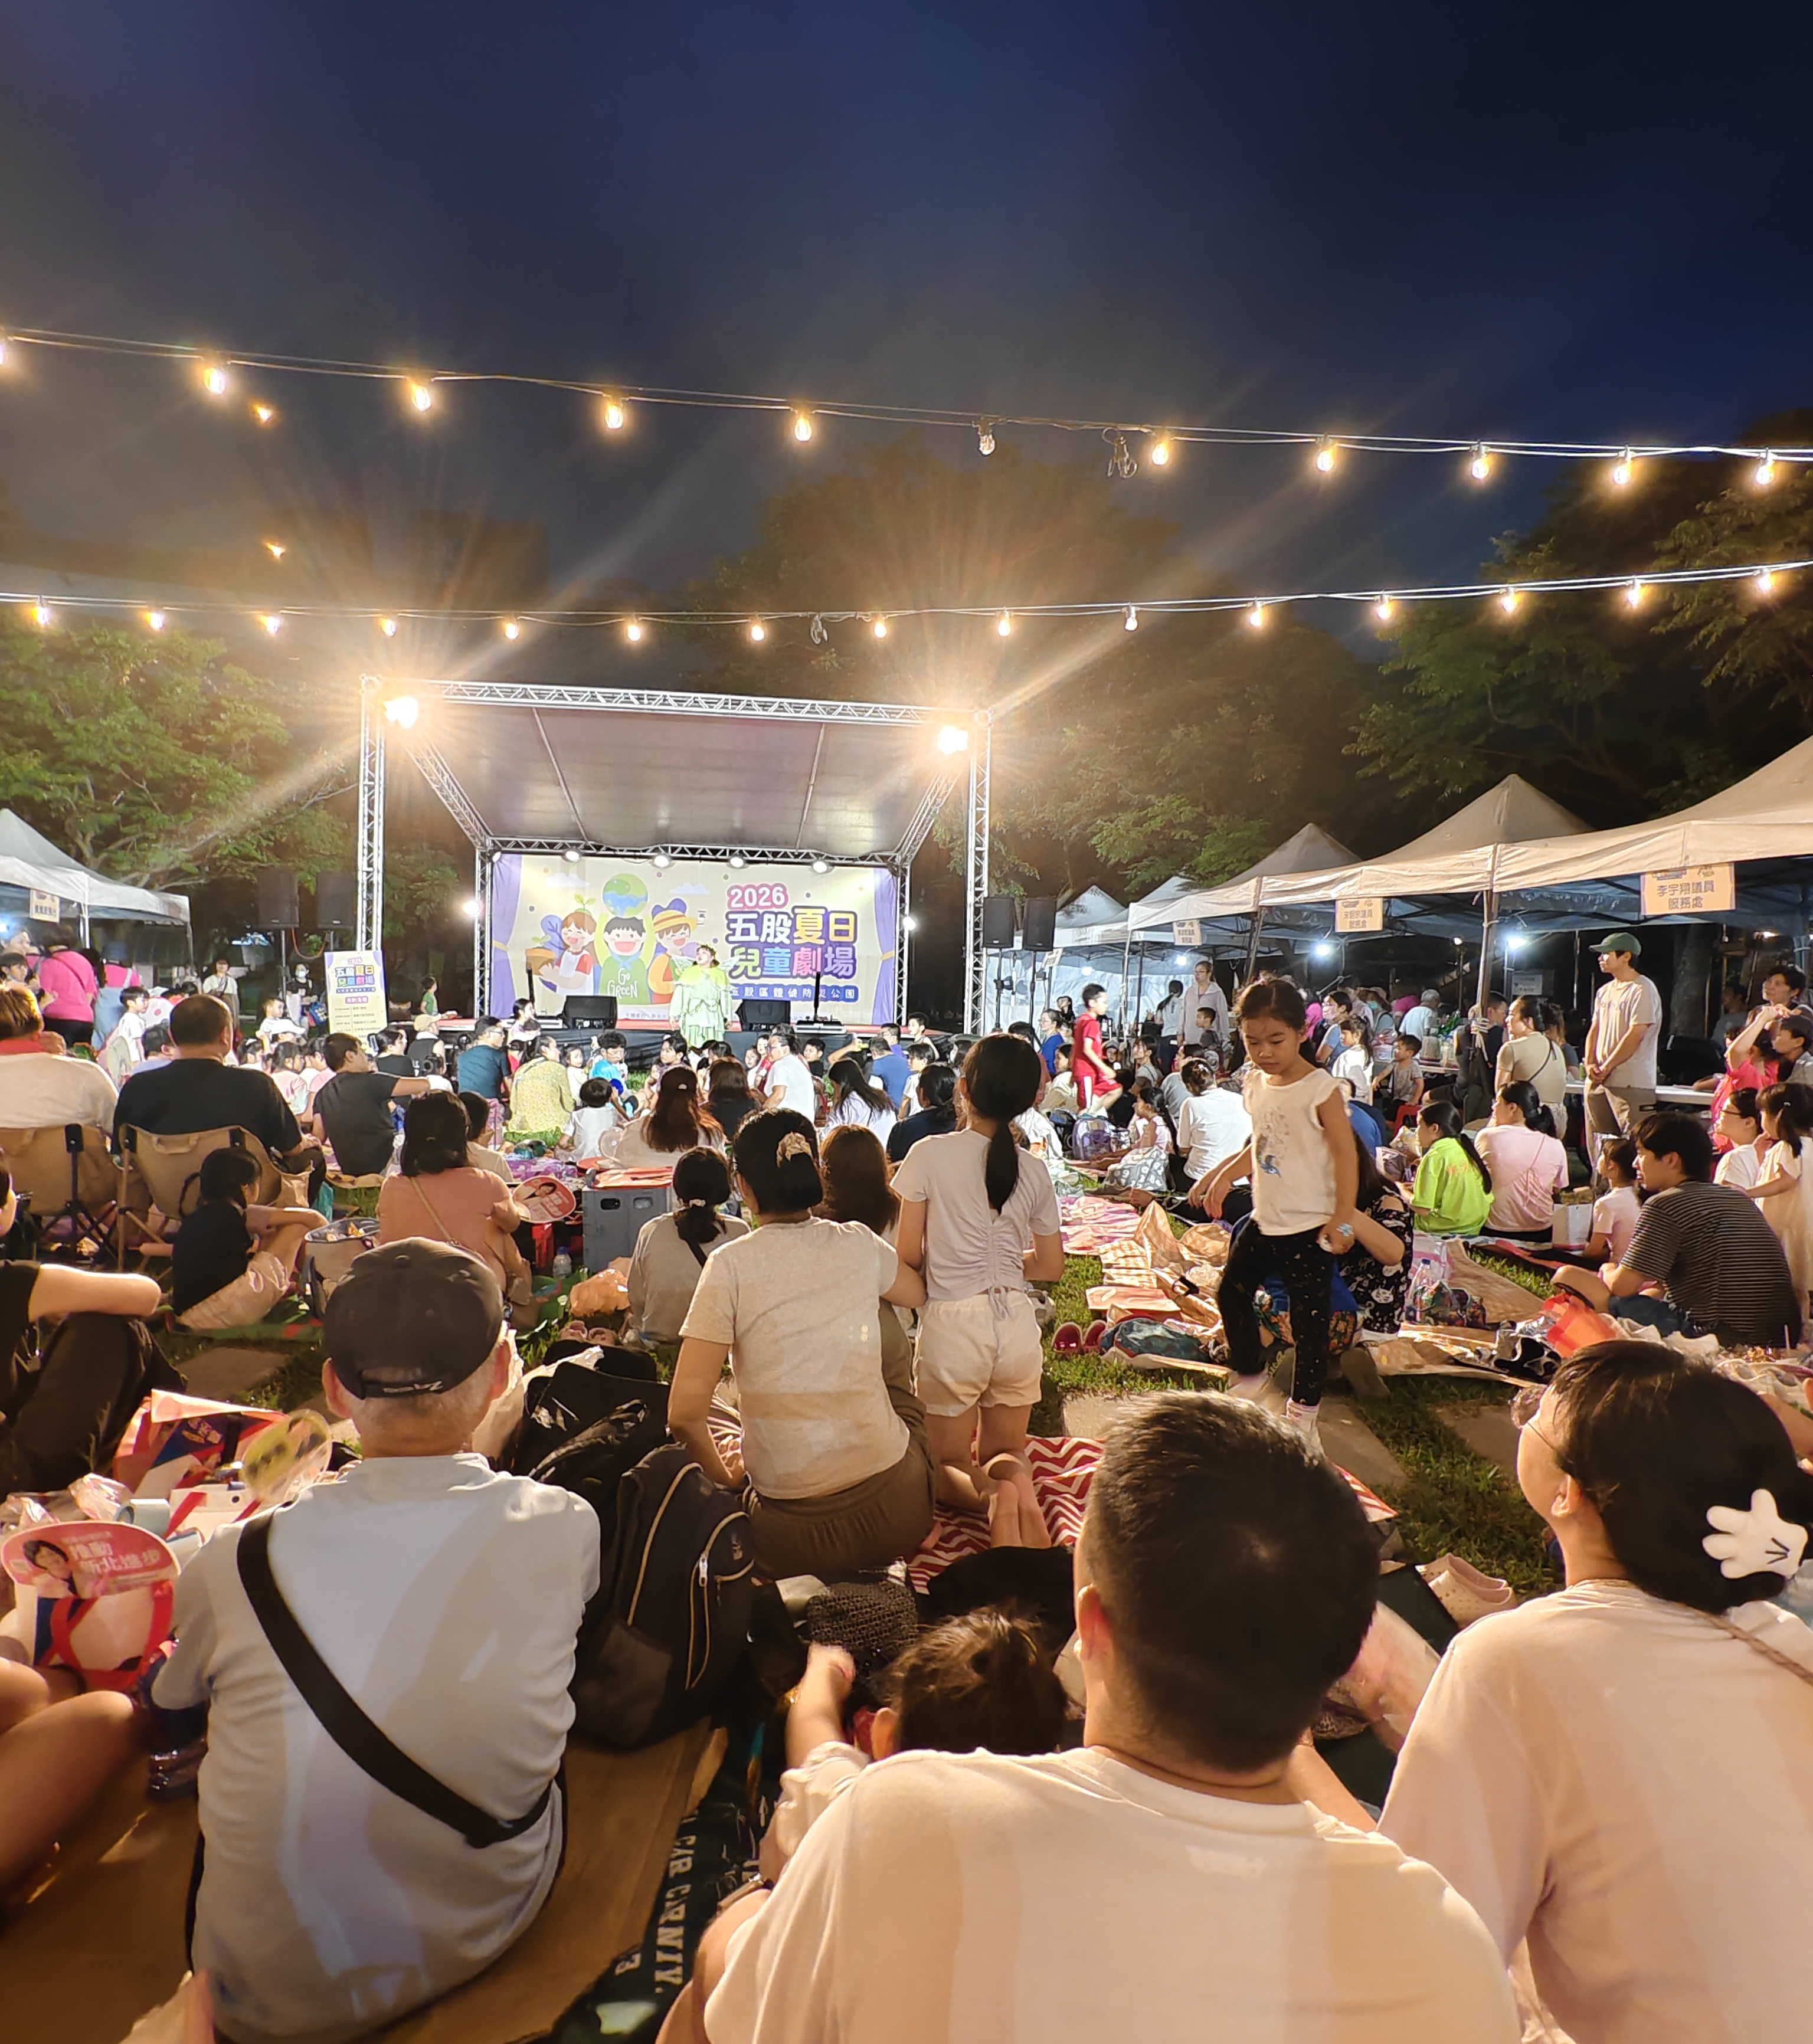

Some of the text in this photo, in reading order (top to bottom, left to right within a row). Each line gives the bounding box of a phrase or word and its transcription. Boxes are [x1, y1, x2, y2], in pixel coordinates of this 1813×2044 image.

[730, 887, 786, 908] 2026
[728, 908, 855, 945] 五股夏日
[731, 946, 855, 977] 兒童劇場
[618, 968, 631, 985] Go
